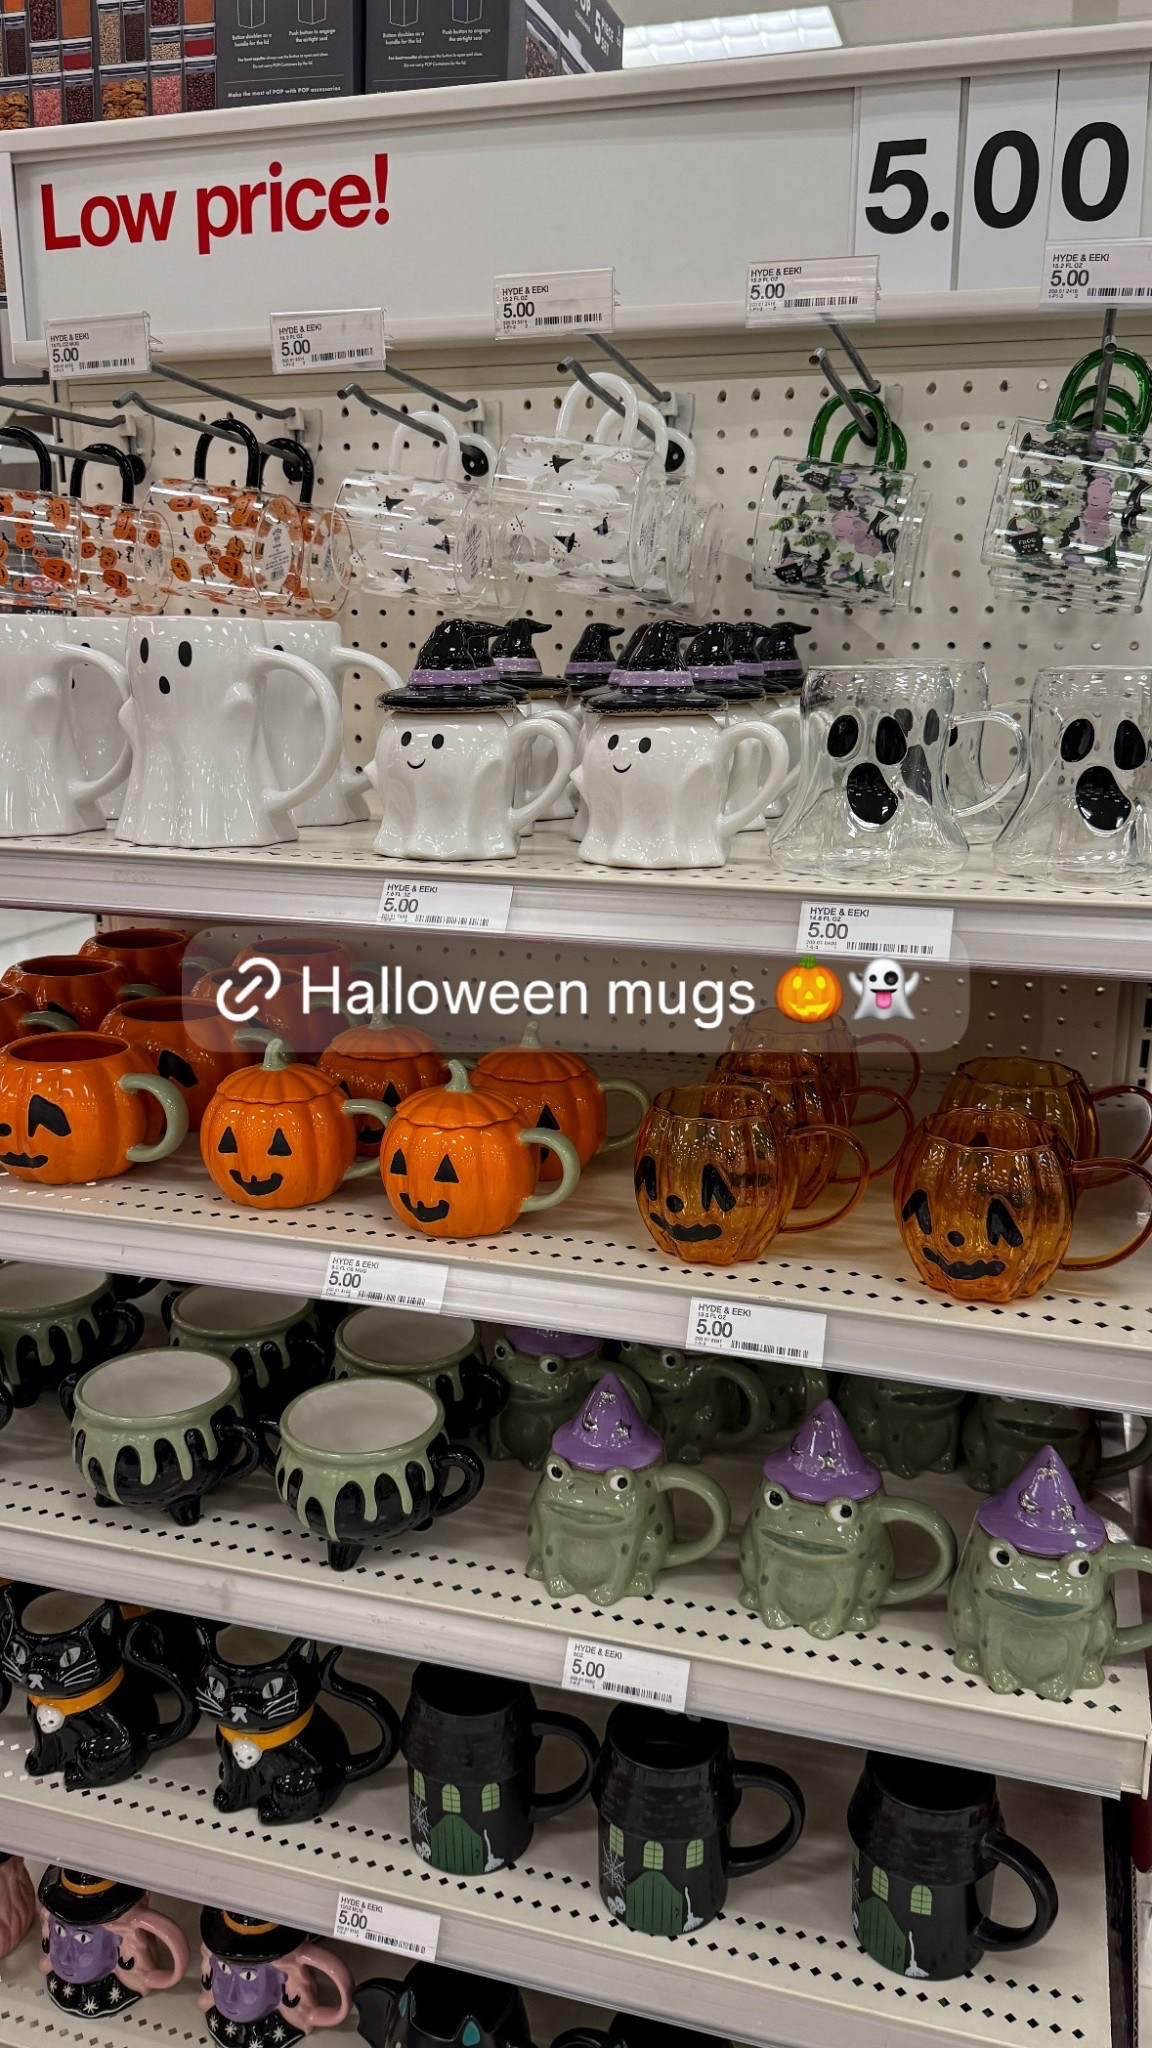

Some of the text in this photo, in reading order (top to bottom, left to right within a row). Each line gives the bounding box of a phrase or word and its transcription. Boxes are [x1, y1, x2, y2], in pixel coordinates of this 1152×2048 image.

[594, 9, 602, 45] 5
[41, 152, 390, 255] Low price!
[1052, 254, 1078, 262] HYDE
[751, 269, 774, 277] HYDE
[1050, 269, 1089, 286] 5.00
[502, 287, 524, 296] HYDE
[750, 283, 785, 300] 5.00
[503, 302, 535, 318] 5.00
[279, 326, 298, 335] HYDE
[52, 347, 79, 363] 5.00
[281, 339, 310, 356] 5.00
[388, 884, 410, 892] HYDE
[383, 898, 418, 913] 5.00
[810, 907, 836, 916] HYDE
[838, 908, 845, 916] &
[808, 922, 848, 939] 5.00
[332, 1257, 354, 1266] HYDE
[328, 1271, 362, 1288] 5.00
[698, 1304, 722, 1313] HYDE
[696, 1319, 733, 1338] 5.00
[574, 1643, 596, 1655] HYDE
[598, 1648, 603, 1656] &
[572, 1658, 605, 1679] 5.00
[341, 1896, 359, 1906] HYDE
[339, 1910, 368, 1929] 5.00
